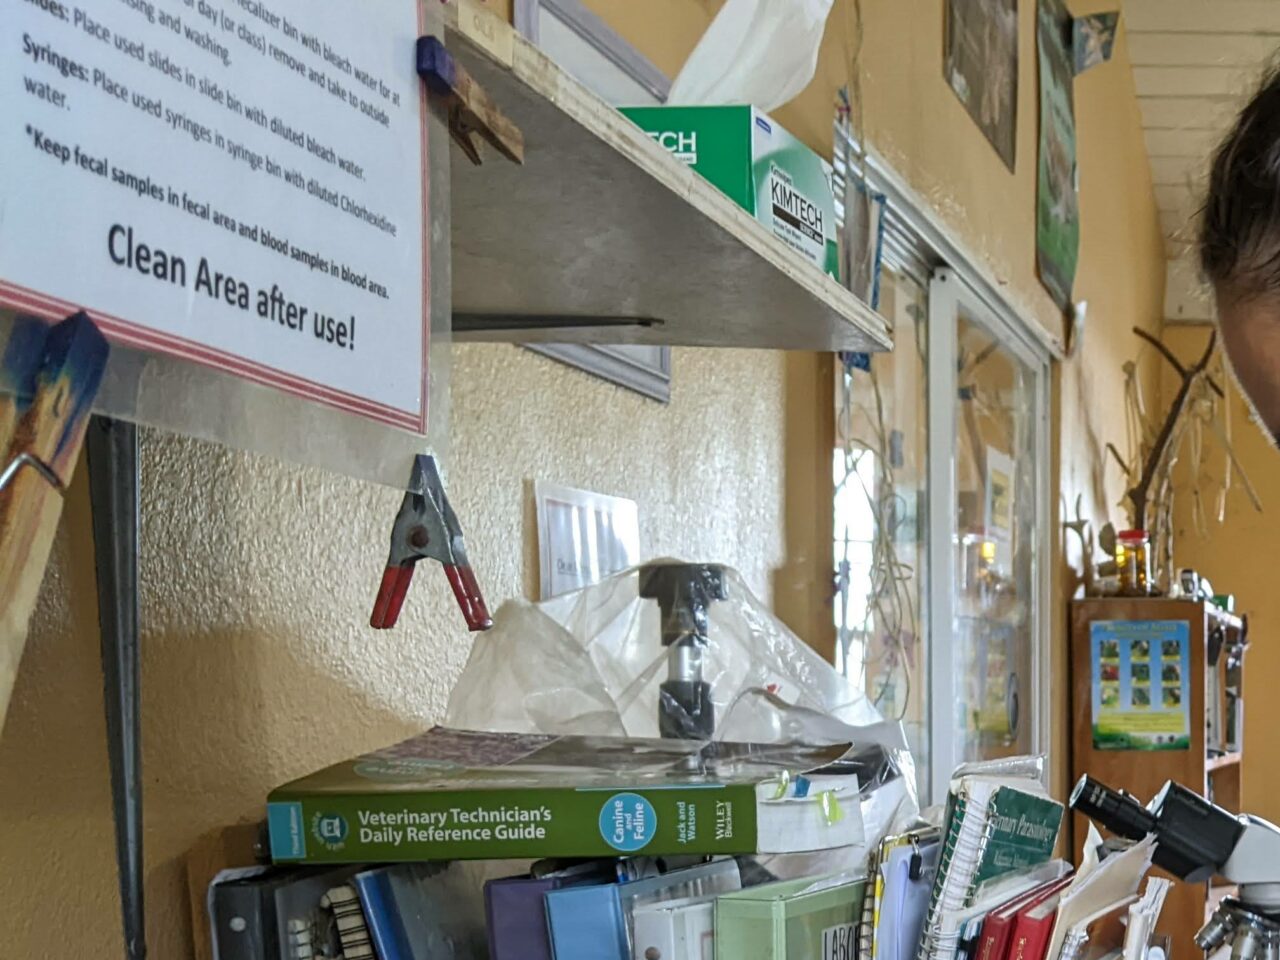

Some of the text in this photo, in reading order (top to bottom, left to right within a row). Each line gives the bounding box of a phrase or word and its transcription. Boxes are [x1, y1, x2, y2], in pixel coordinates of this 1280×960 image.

[158, 10, 181, 34] and
[198, 0, 218, 26] day
[221, 9, 234, 32] (or
[238, 23, 266, 55] class)
[269, 43, 306, 77] remove
[308, 67, 325, 88] and
[328, 78, 347, 101] take
[349, 91, 358, 108] to
[238, 0, 280, 29] ecalizer
[283, 17, 298, 40] bin
[301, 32, 321, 56] with
[323, 43, 351, 74] bleach
[354, 66, 377, 90] water
[380, 80, 391, 99] for
[23, 75, 71, 112] water.
[73, 7, 110, 43] Place
[114, 33, 145, 61] used
[148, 50, 182, 82] slides
[185, 67, 196, 89] in
[199, 76, 224, 104] slide
[227, 90, 242, 115] bin
[245, 104, 267, 128] with
[270, 117, 304, 148] diluted
[307, 137, 336, 165] bleach
[23, 32, 89, 82] Syringes:
[93, 68, 129, 102] Place
[132, 92, 162, 119] used
[165, 108, 212, 143] syringes
[215, 132, 225, 149] in
[228, 140, 263, 171] syringe
[266, 156, 281, 178] bin
[284, 168, 305, 191] with
[307, 180, 338, 208] diluted
[74, 144, 108, 178] fecal
[111, 166, 164, 202] samples
[167, 186, 179, 207] in
[182, 193, 210, 221] fecal
[213, 210, 236, 233] area
[238, 221, 258, 242] and
[260, 228, 289, 256] blood
[290, 244, 329, 272] samples
[331, 259, 340, 276] in
[341, 264, 367, 290] blood
[368, 279, 390, 300] area.
[771, 177, 823, 232] KIMTECH
[107, 223, 356, 352] Clean Area after use!
[358, 806, 551, 827] Veterinary Technician's
[360, 828, 402, 846] Daily
[407, 826, 491, 842] Reference
[495, 824, 546, 840] Guide
[613, 800, 625, 844] Canine
[634, 802, 644, 840] Feline
[677, 801, 686, 844] Jack and
[687, 804, 695, 840] Watson
[716, 800, 724, 840] WILEY
